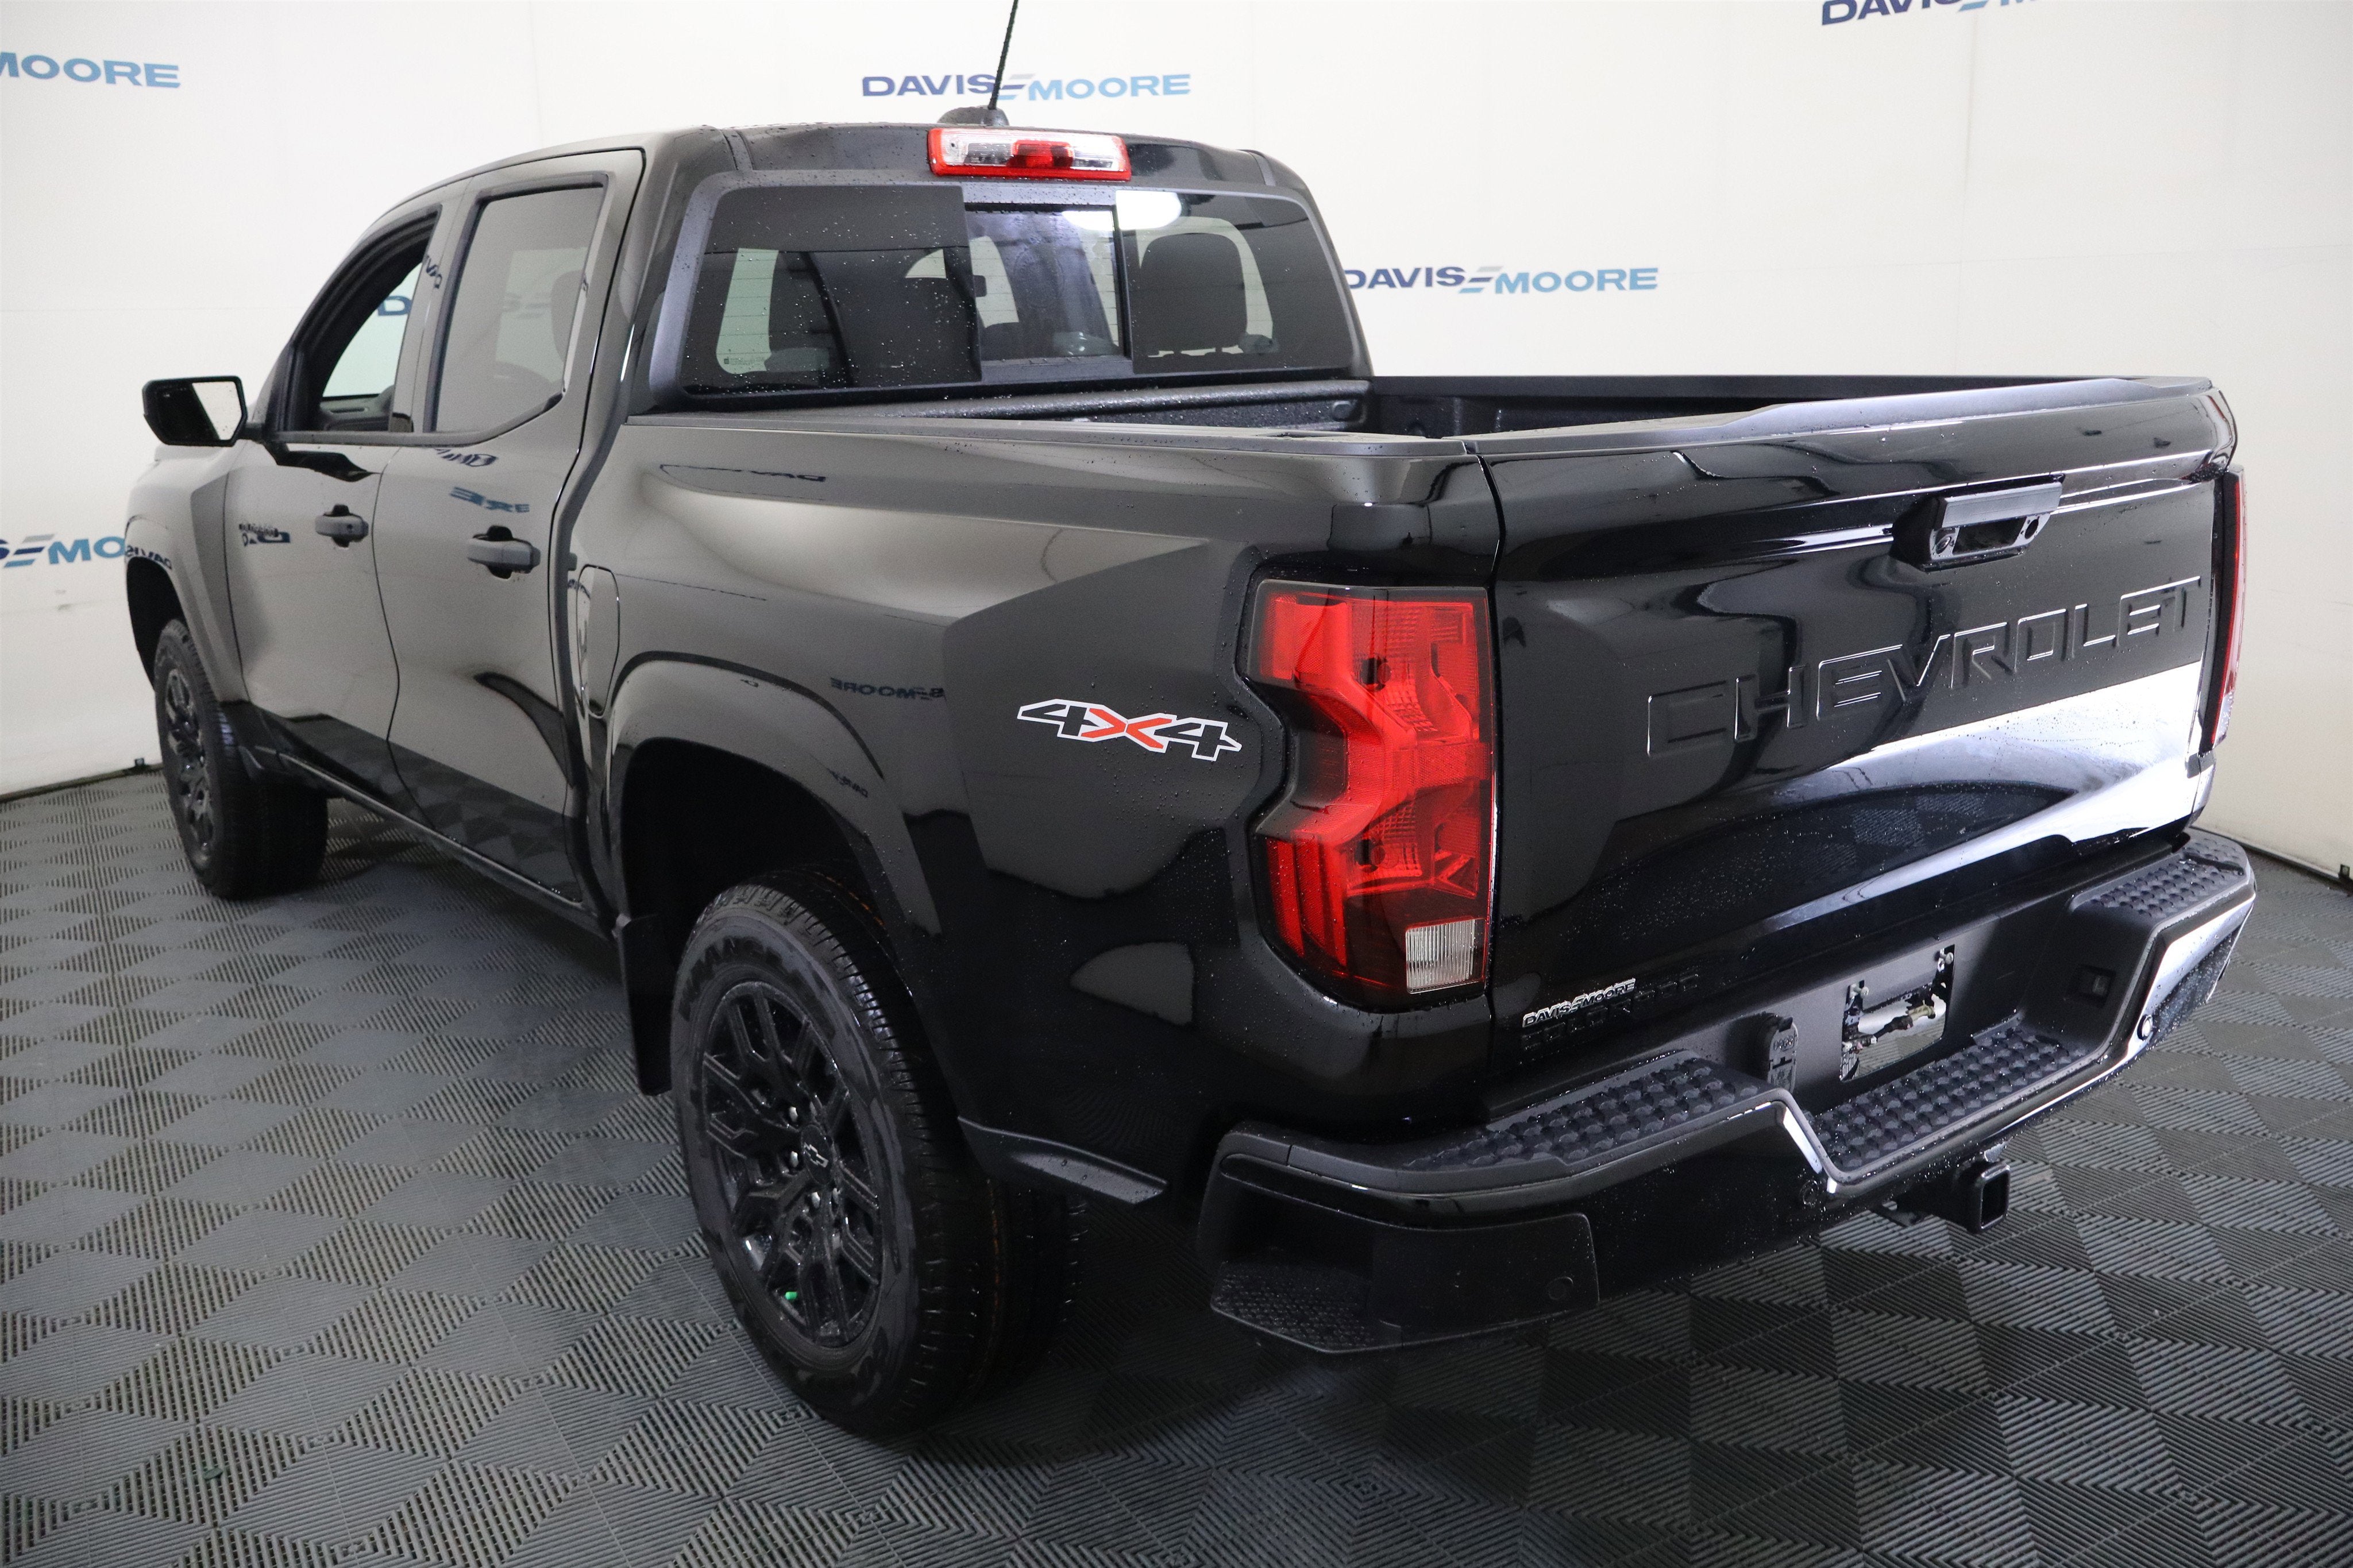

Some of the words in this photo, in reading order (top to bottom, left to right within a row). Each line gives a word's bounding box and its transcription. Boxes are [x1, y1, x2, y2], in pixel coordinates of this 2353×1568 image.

[1822, 0, 1962, 25] DAV
[862, 74, 997, 96] DAVIS
[1028, 74, 1191, 101] MOORE
[1344, 267, 1465, 289] DAVIS
[1495, 268, 1658, 294] MOORE
[1647, 576, 2201, 756] CHEVROLET
[1523, 1001, 1571, 1027] DAVIS
[1580, 978, 1636, 1008] MOORE
